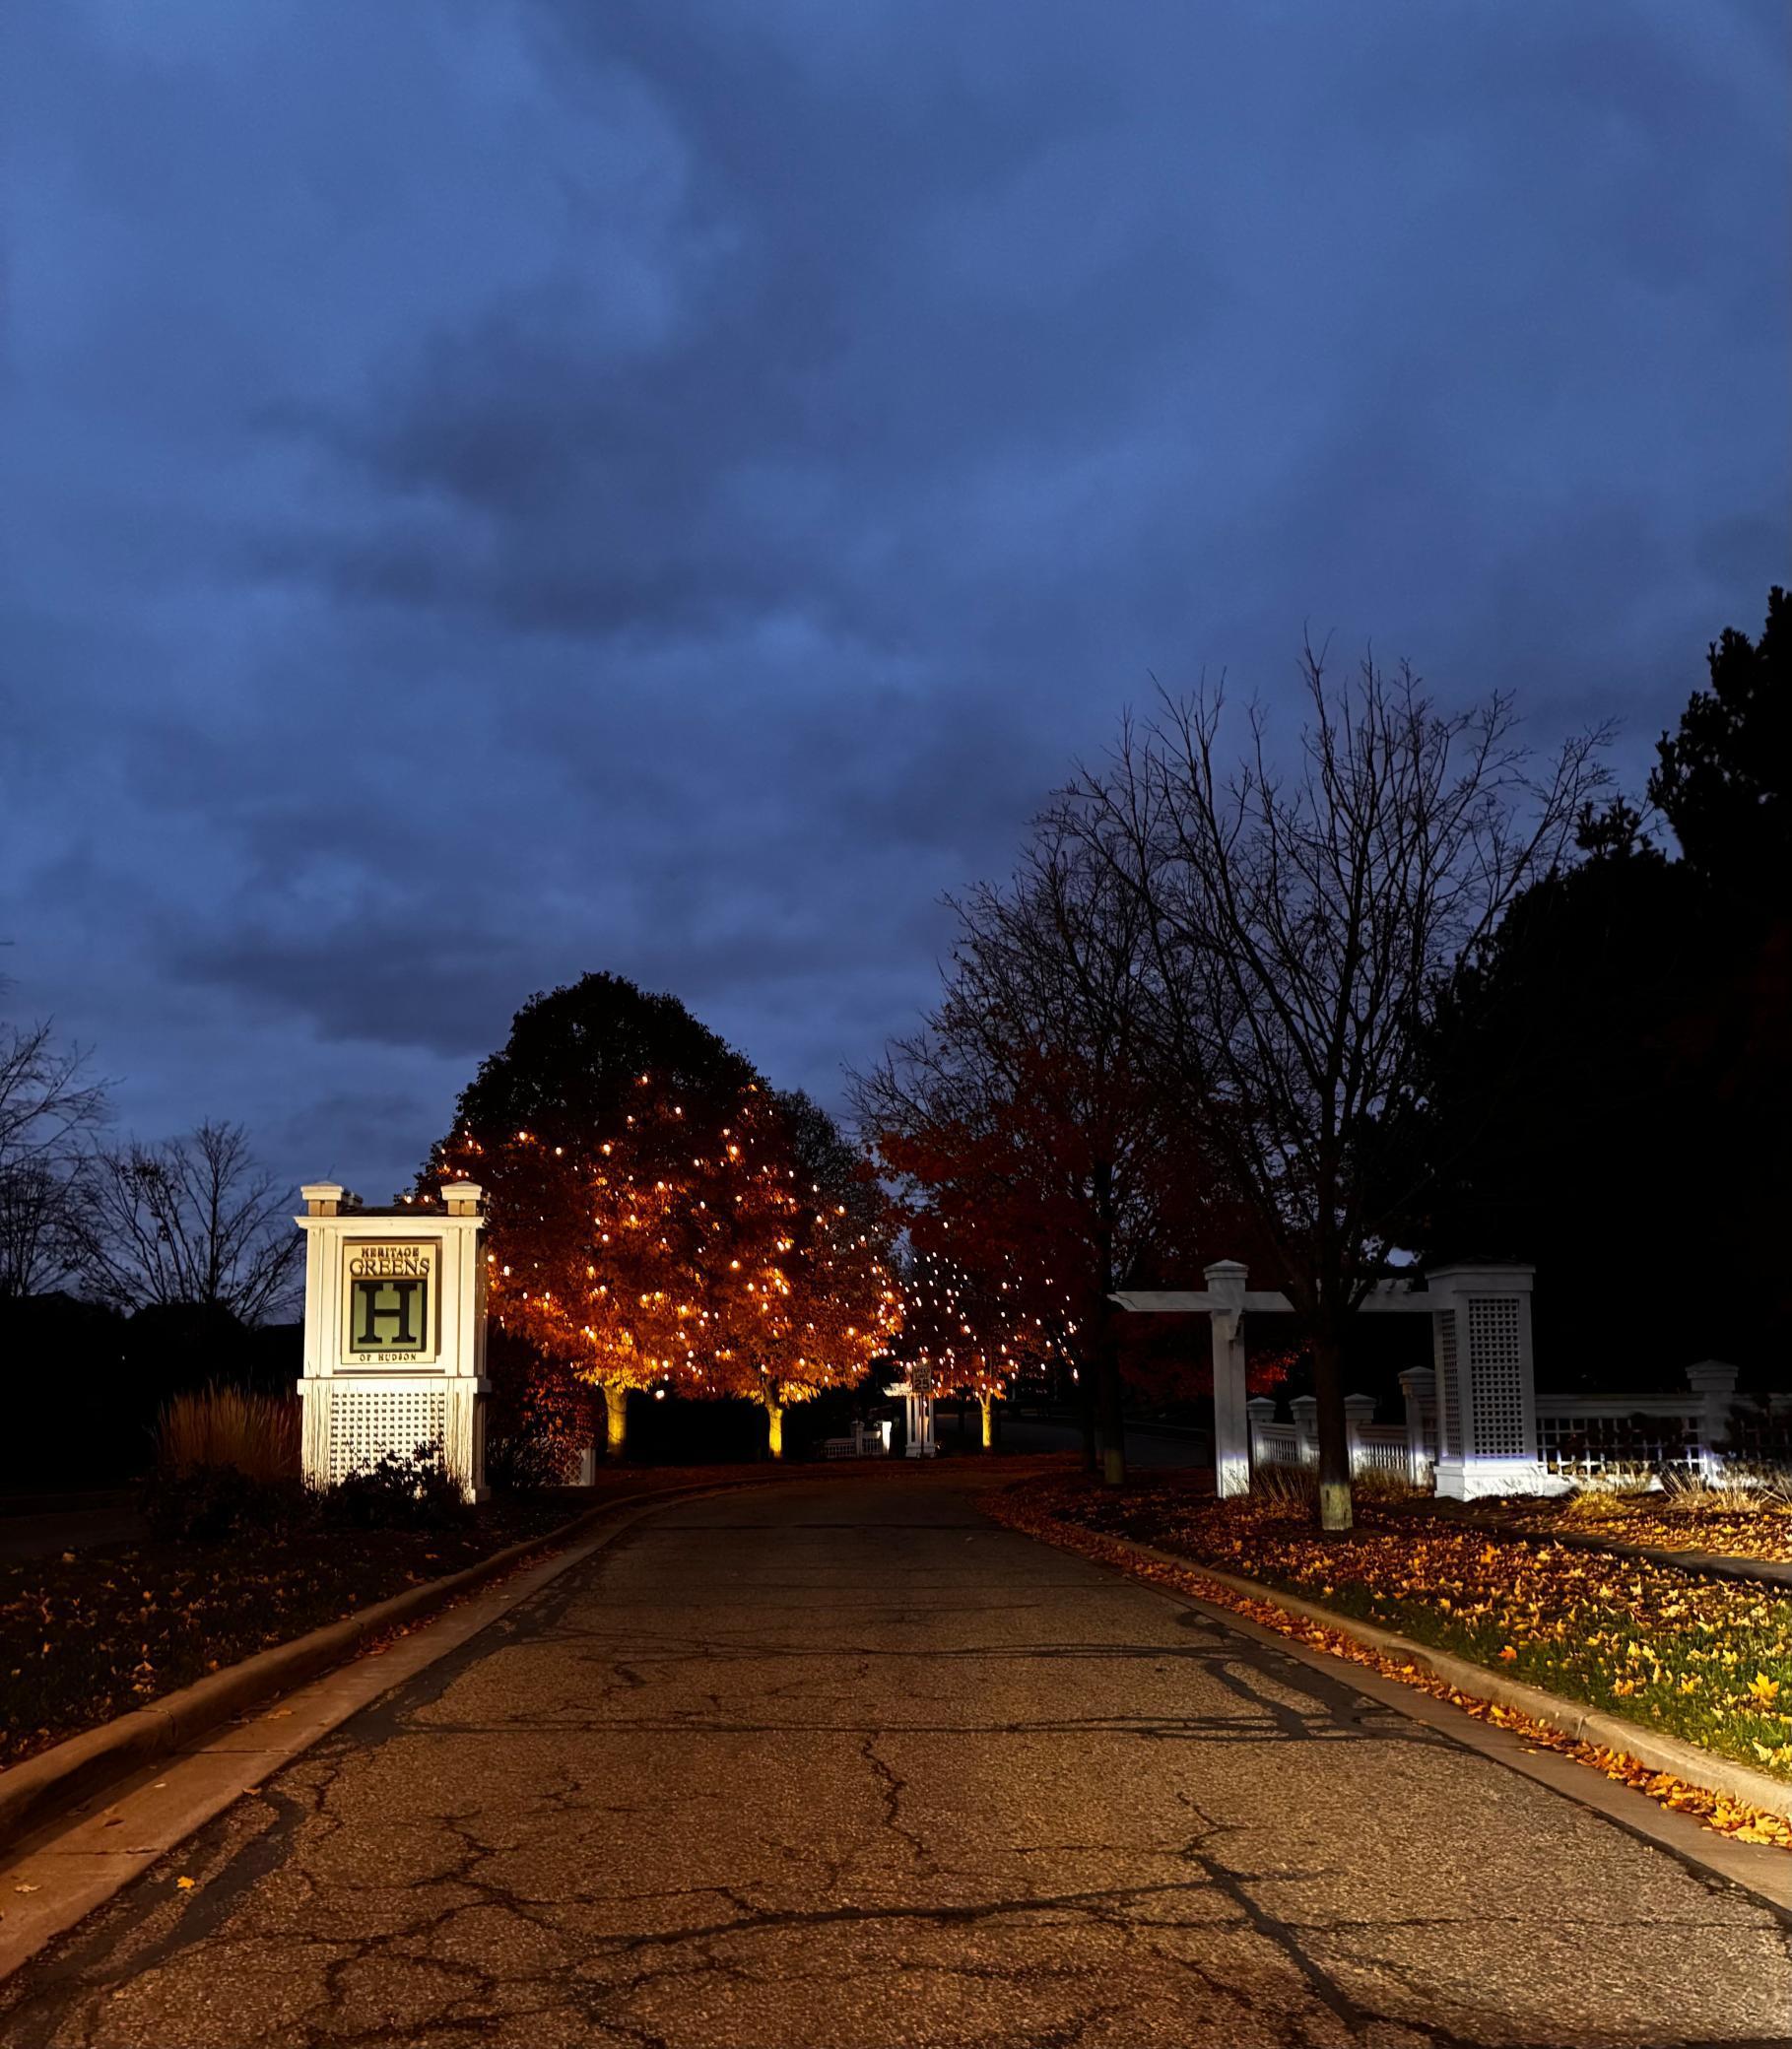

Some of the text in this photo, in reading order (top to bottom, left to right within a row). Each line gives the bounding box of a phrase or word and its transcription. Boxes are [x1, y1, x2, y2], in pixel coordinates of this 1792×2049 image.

[361, 1246, 420, 1258] HERITAGE
[350, 1257, 431, 1277] GREENS
[358, 1284, 418, 1344] H
[914, 1379, 930, 1389] 25
